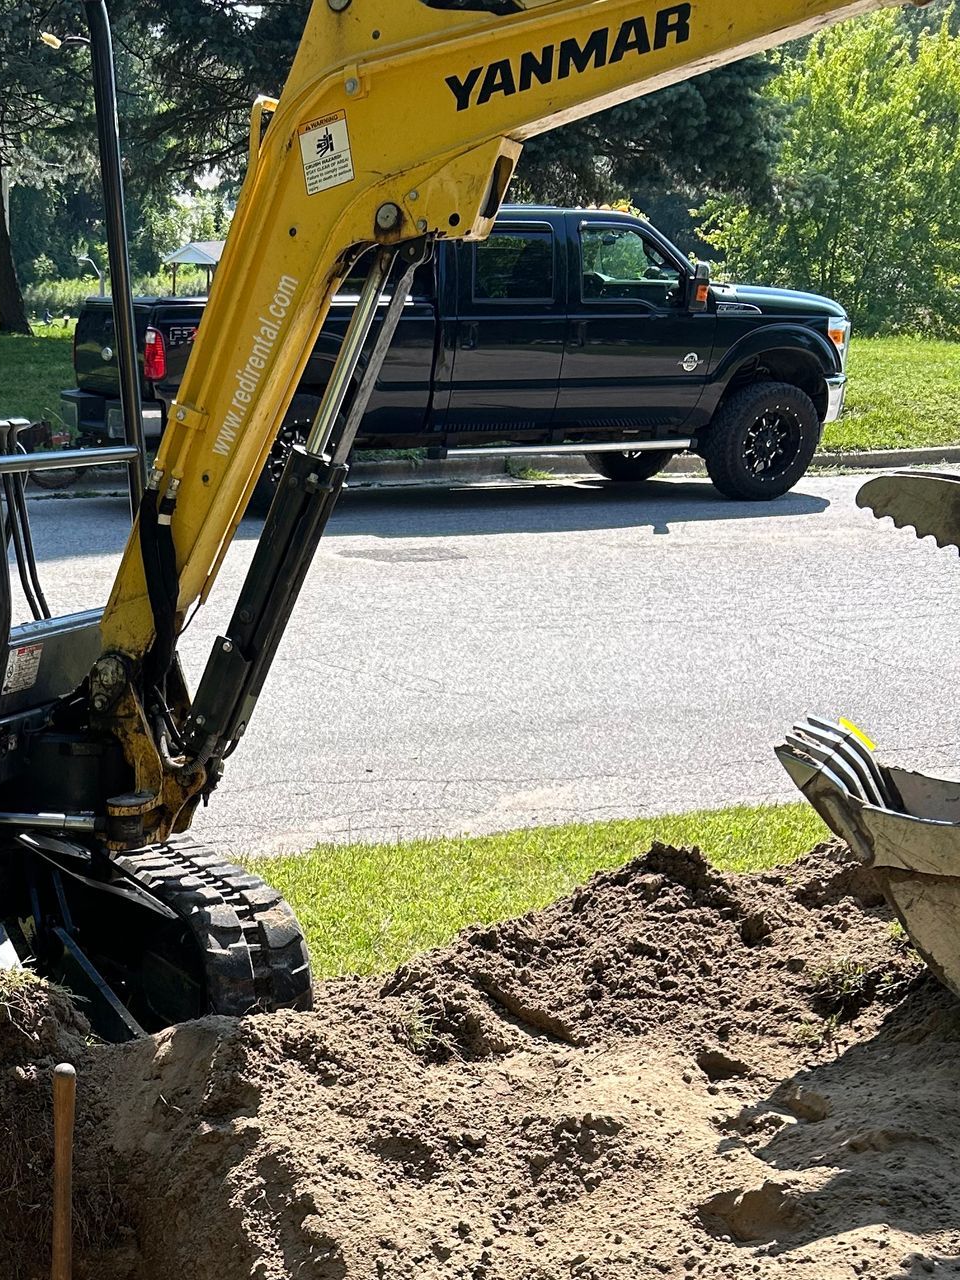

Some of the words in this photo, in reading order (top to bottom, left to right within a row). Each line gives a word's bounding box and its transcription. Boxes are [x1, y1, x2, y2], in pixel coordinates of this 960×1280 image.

[445, 2, 691, 112] YANMAR
[311, 114, 338, 128] WARNING
[317, 164, 330, 172] CLEAR
[212, 275, 299, 457] www.redirental.com
